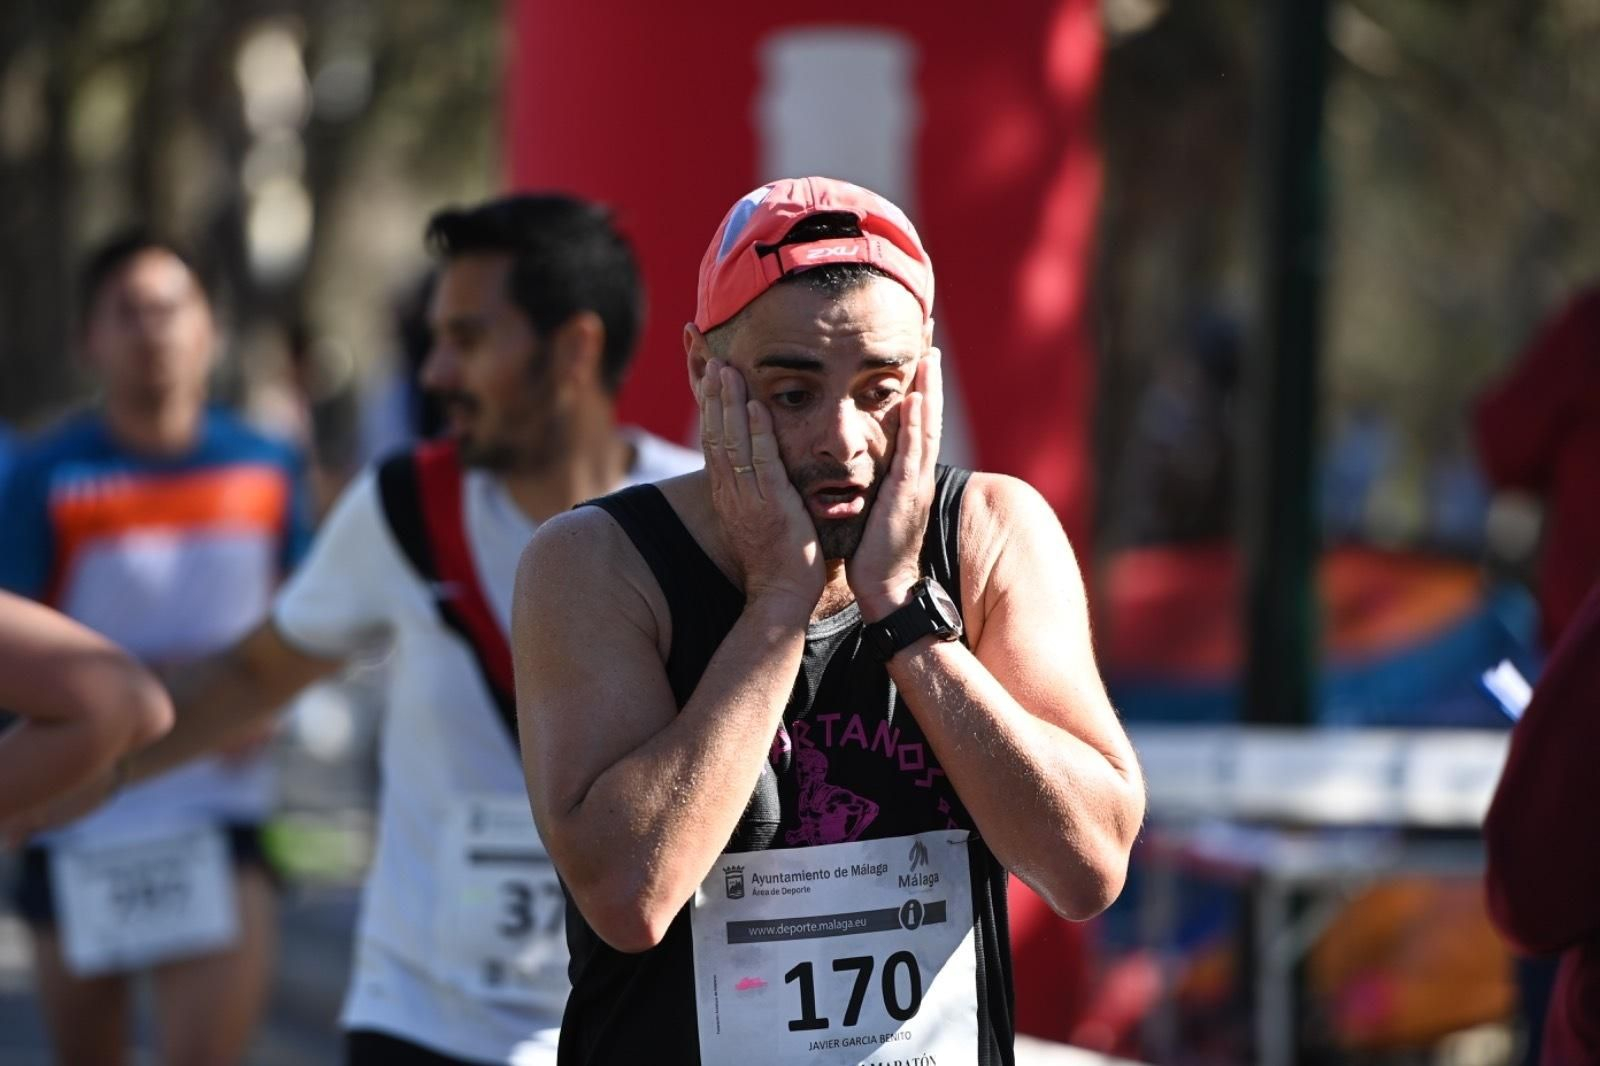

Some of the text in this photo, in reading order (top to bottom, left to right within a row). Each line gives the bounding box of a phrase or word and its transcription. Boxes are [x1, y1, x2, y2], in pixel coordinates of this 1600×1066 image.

[751, 863, 888, 887] Ayuntamiento de Málaga
[898, 872, 940, 888] Málaga
[771, 887, 780, 895] de
[781, 886, 811, 896] Deporte
[748, 918, 867, 936] www.deporte.malaga.eu
[784, 950, 922, 1032] 170
[808, 1031, 912, 1051] JAVIER GARCIA BENITO
